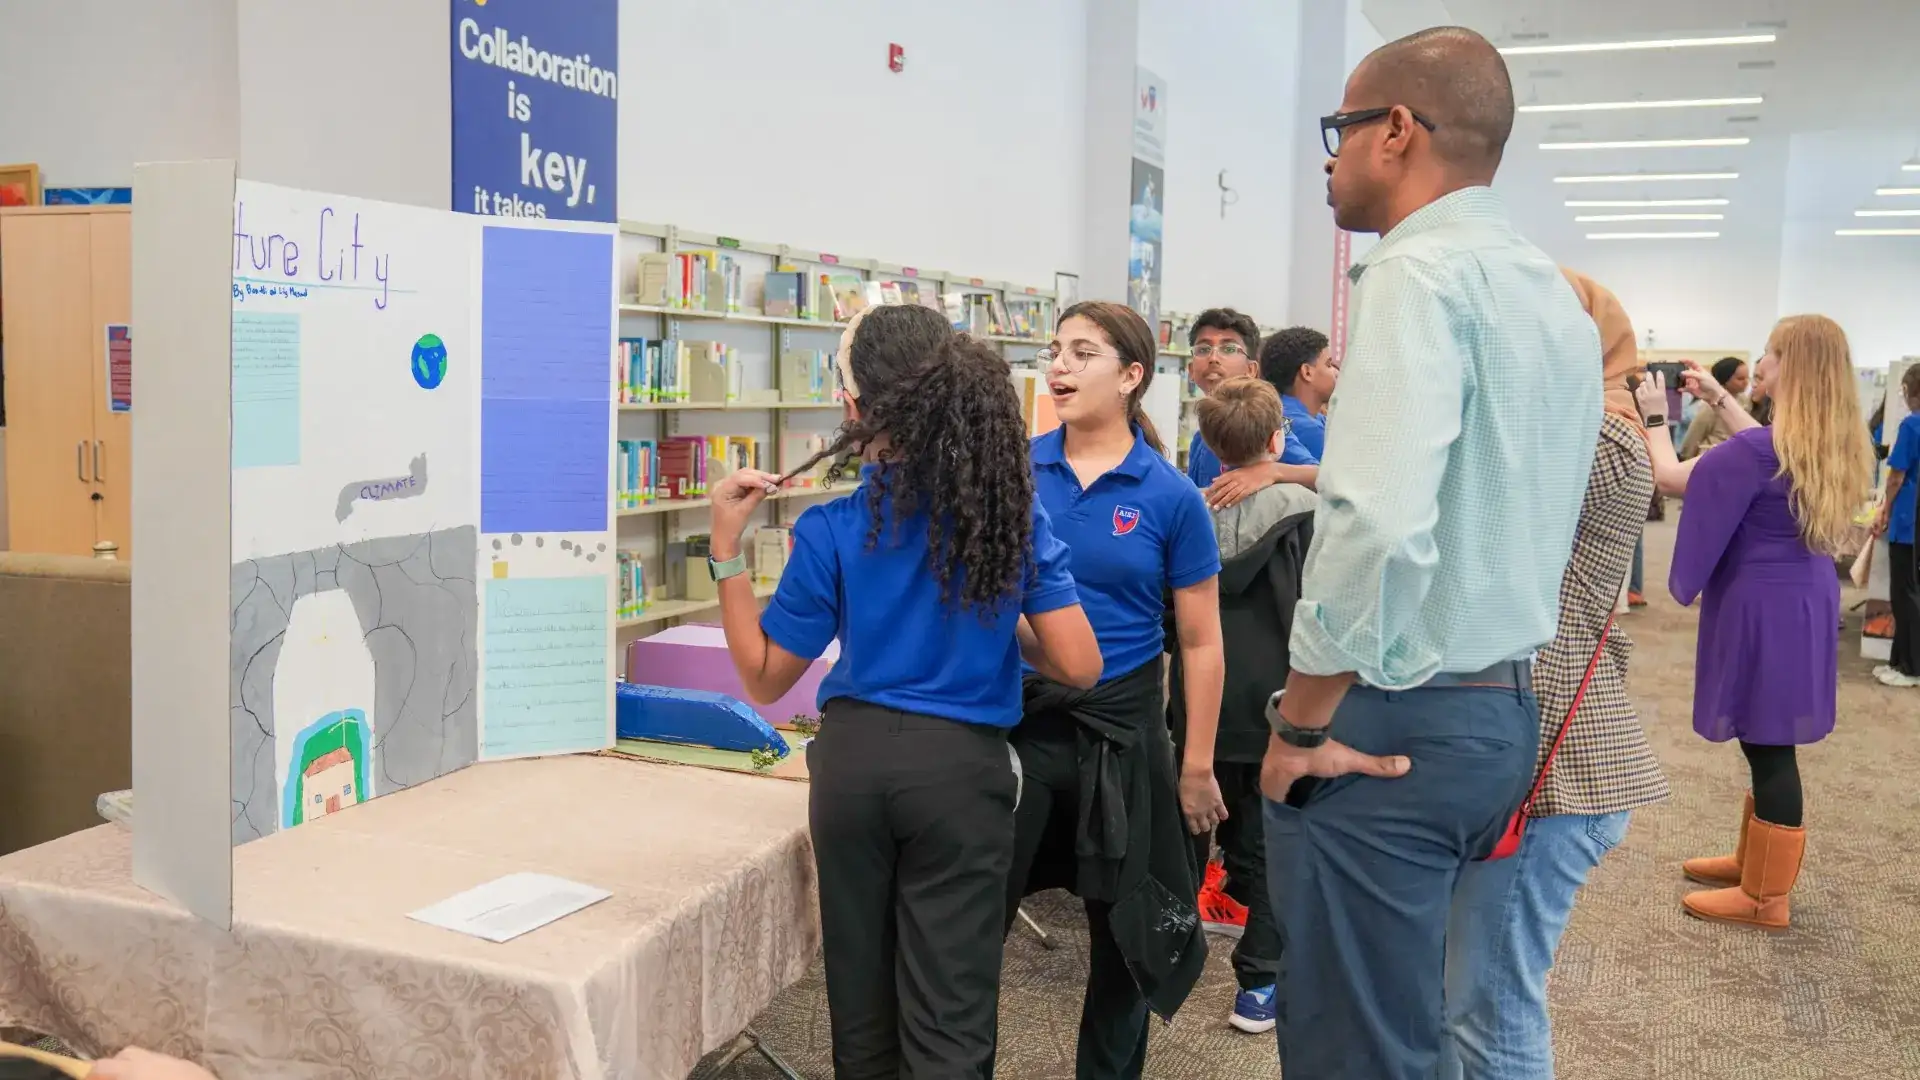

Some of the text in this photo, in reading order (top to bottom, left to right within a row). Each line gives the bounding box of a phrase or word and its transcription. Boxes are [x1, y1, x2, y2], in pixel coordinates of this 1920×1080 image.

[460, 18, 617, 99] Collaboration
[508, 81, 531, 121] is
[521, 132, 595, 207] key,
[474, 186, 546, 218] it takes
[319, 207, 389, 310] City
[360, 475, 417, 500] CLIMATE
